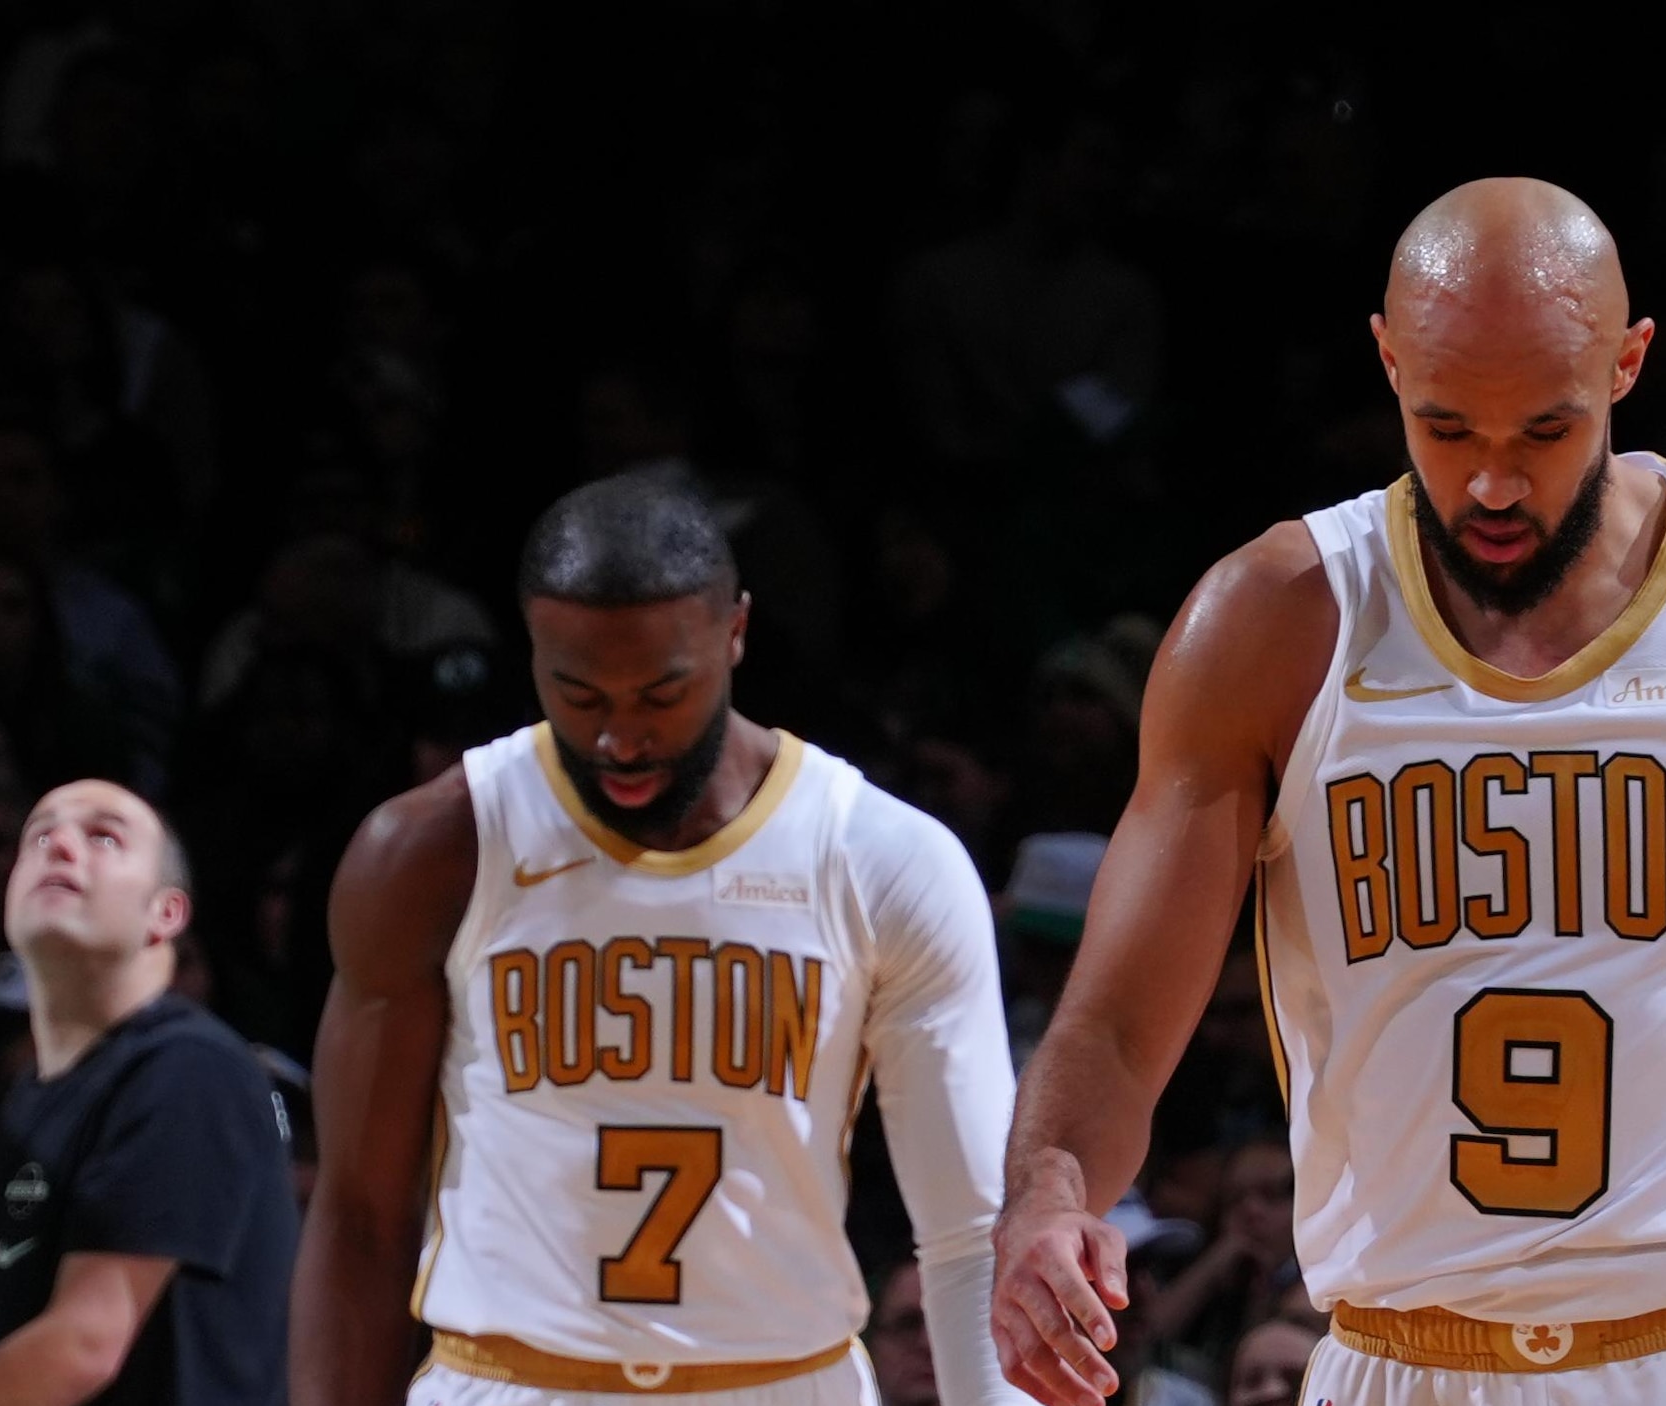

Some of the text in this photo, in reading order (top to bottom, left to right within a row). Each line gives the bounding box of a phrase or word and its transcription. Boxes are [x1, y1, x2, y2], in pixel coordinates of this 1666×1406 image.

[490, 936, 822, 1101] BOSTON
[1450, 986, 1614, 1218] 9
[597, 1126, 722, 1304] 7
